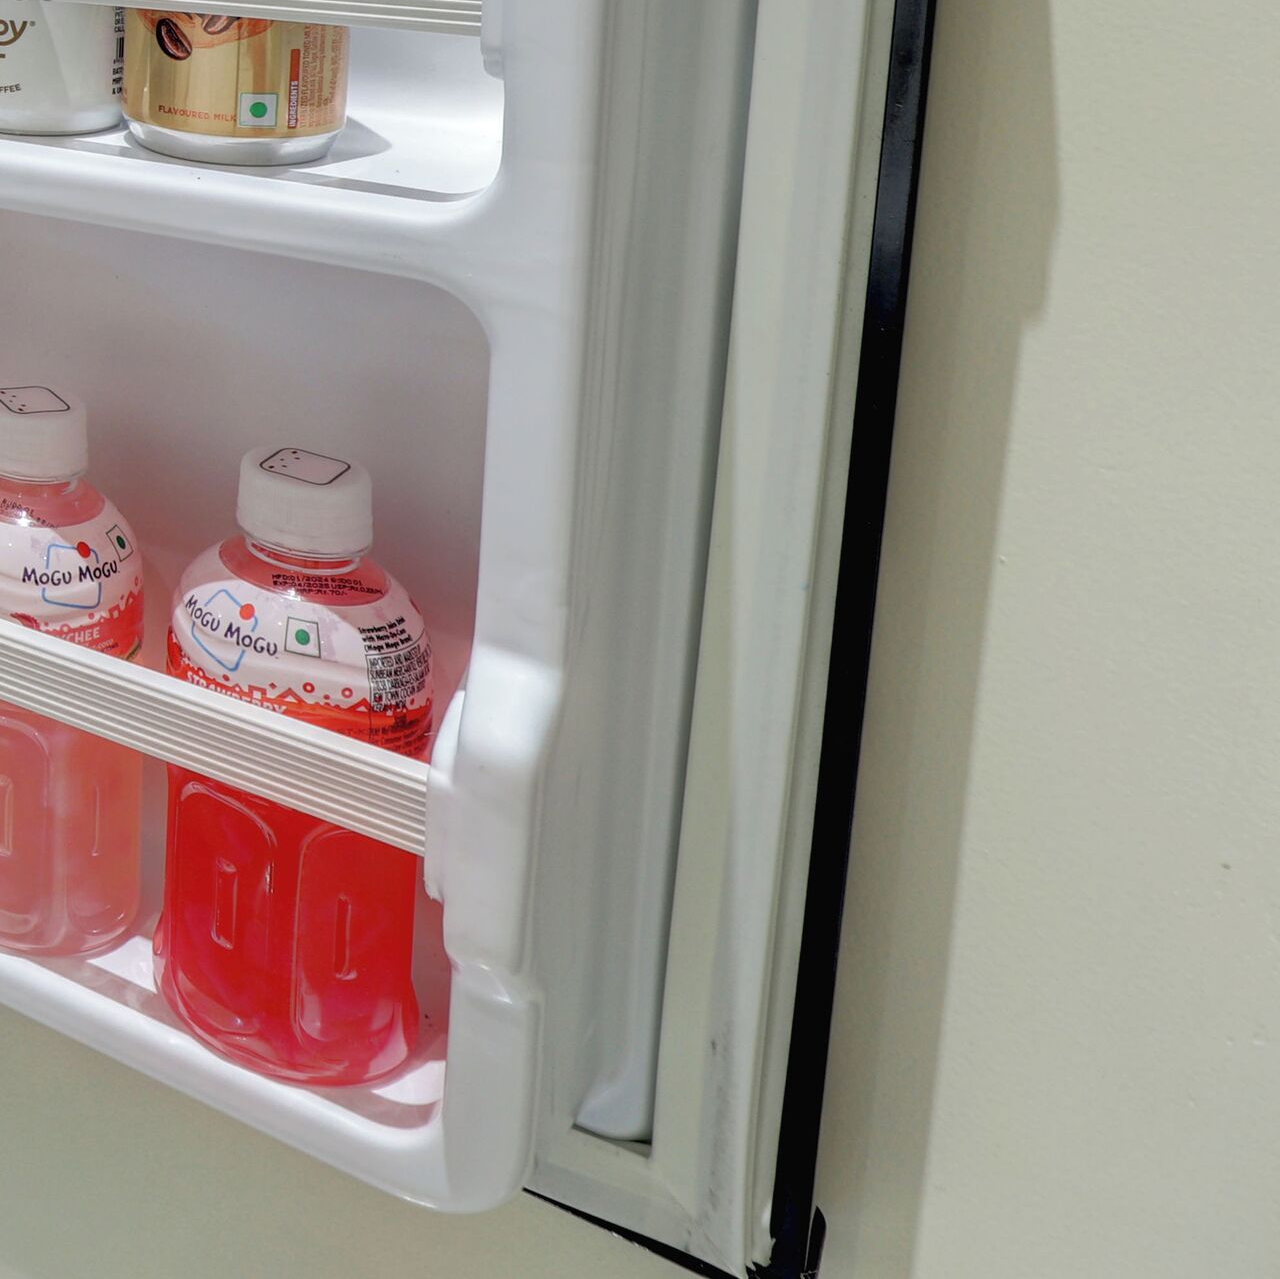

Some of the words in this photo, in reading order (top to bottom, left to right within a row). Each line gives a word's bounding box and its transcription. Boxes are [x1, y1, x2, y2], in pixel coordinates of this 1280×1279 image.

[158, 104, 210, 120] FLAVOURED
[213, 112, 236, 122] MILK
[290, 80, 299, 127] INGREDIENTS
